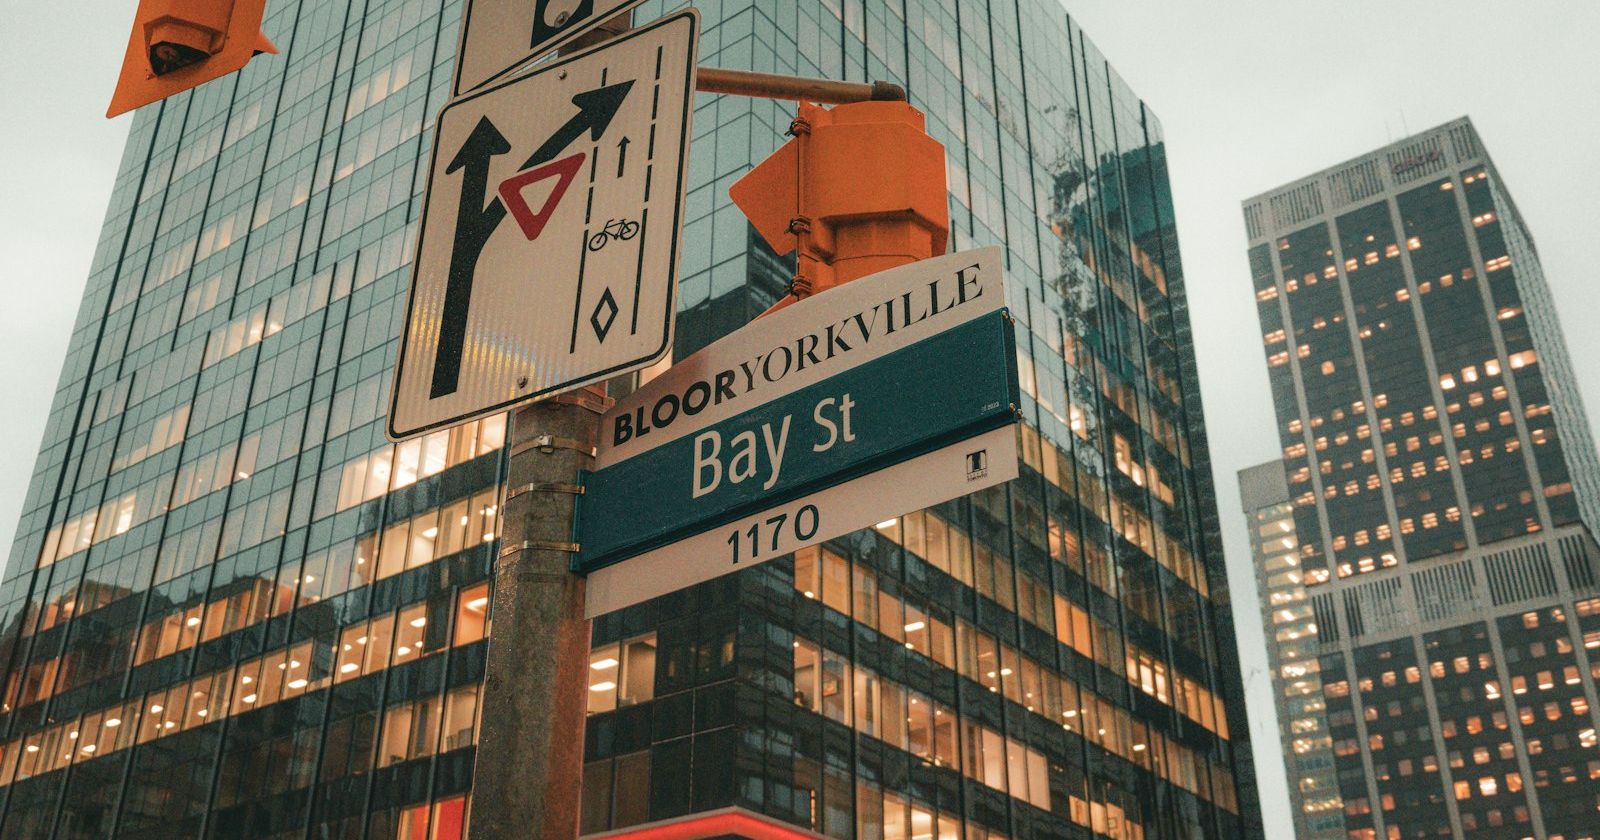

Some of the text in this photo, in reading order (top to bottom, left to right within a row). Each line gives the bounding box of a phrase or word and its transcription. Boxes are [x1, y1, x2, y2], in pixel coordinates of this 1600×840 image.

[692, 393, 857, 499] Bay St
[727, 504, 820, 564] 1170
